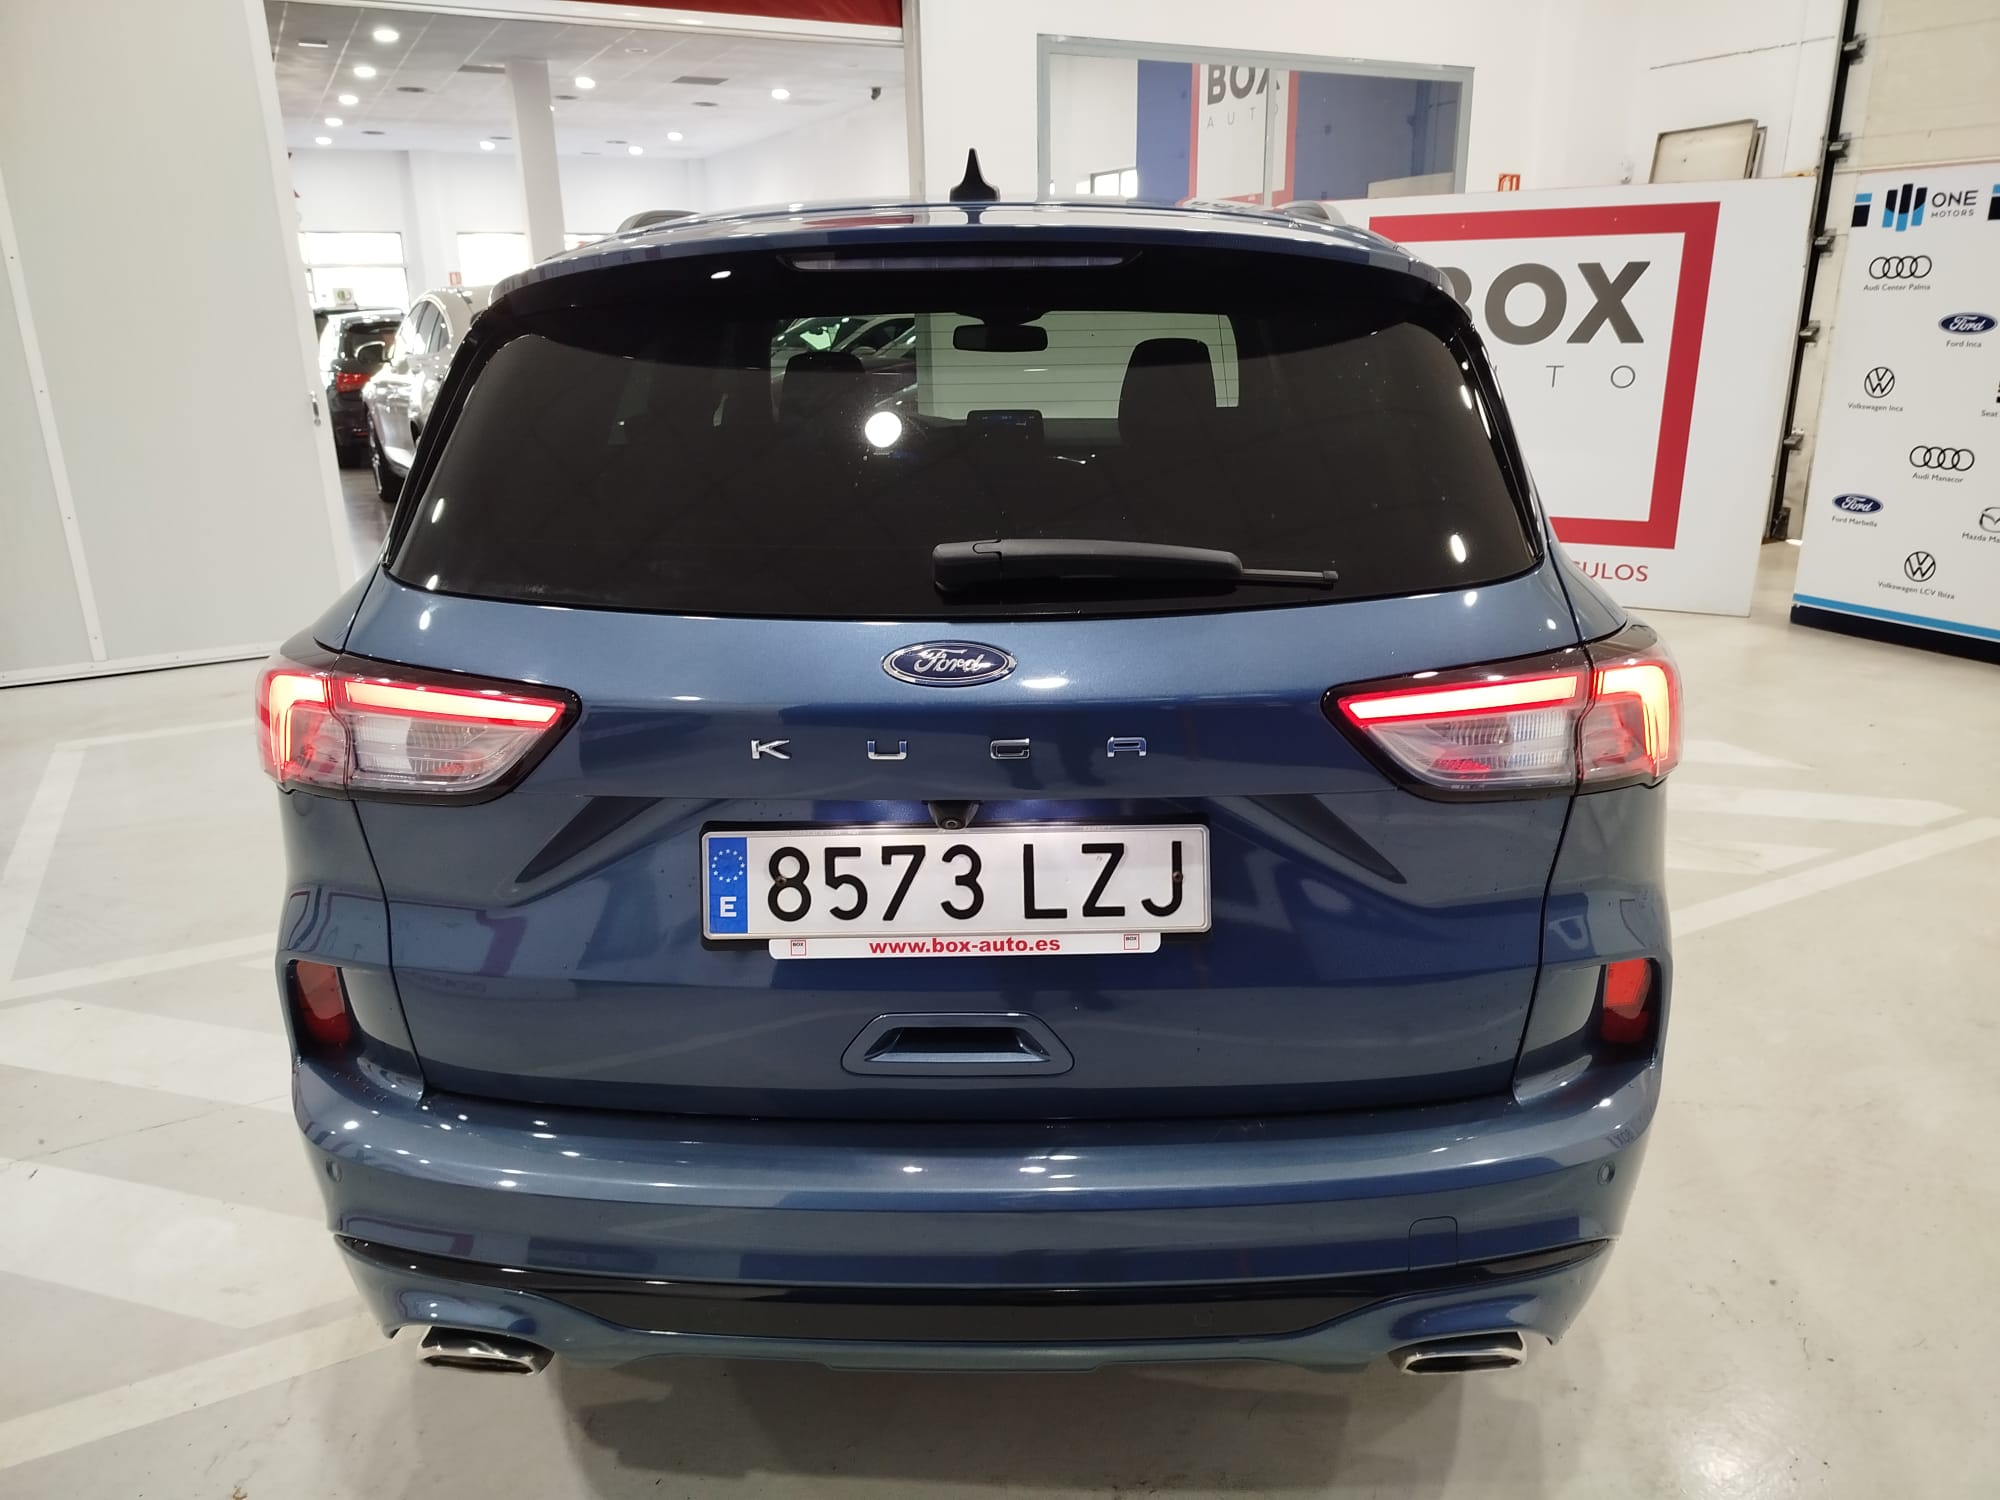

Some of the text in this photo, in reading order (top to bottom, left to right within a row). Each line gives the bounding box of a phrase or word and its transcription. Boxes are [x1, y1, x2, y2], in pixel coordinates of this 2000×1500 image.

[1207, 64, 1280, 105] BO
[1207, 104, 1278, 128] AUT
[1932, 190, 1978, 207] ONE
[1931, 209, 1974, 217] MOTORS
[1949, 315, 1986, 331] Ford
[1848, 402, 1887, 412] Volkswagen
[1912, 472, 1929, 480] Audi
[1842, 496, 1874, 511] Ford
[1573, 561, 1649, 582] ULOS
[1878, 581, 1917, 593] Volkswagen
[914, 648, 986, 673] Ford
[751, 736, 1147, 760] KUGA
[768, 841, 1183, 921] 8573 LZJ
[719, 896, 737, 917] E
[869, 937, 1061, 954] www.box-auto.es
